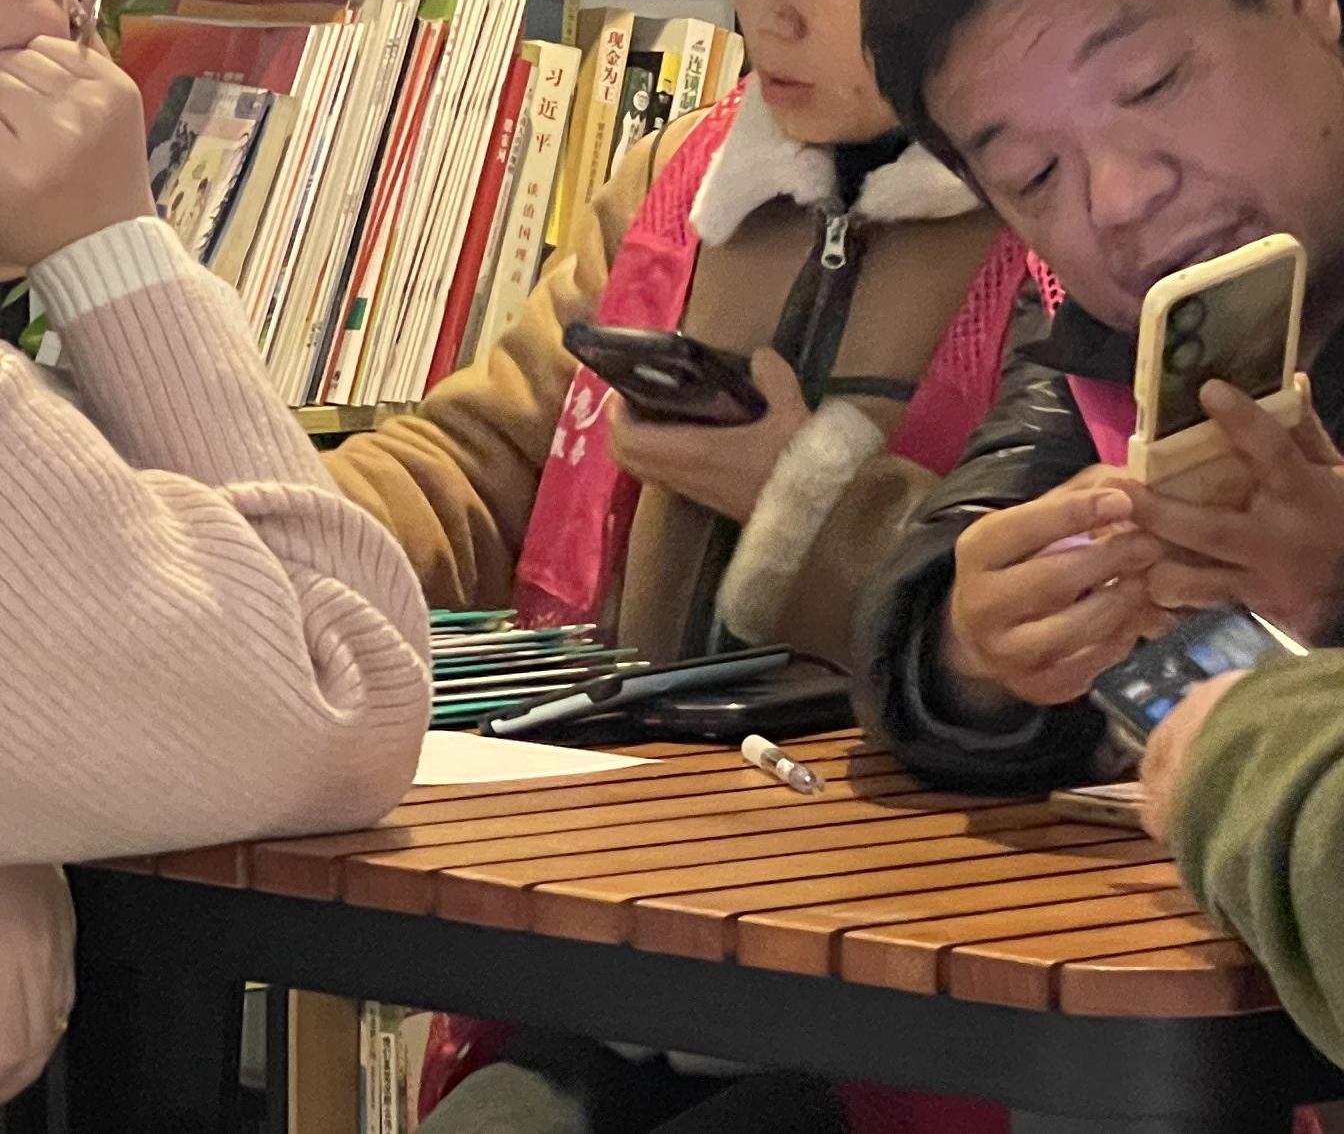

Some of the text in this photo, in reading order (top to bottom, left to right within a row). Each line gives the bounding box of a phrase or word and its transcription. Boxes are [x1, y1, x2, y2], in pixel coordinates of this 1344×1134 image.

[600, 30, 626, 103] 现金为王
[535, 67, 564, 154] 习近平
